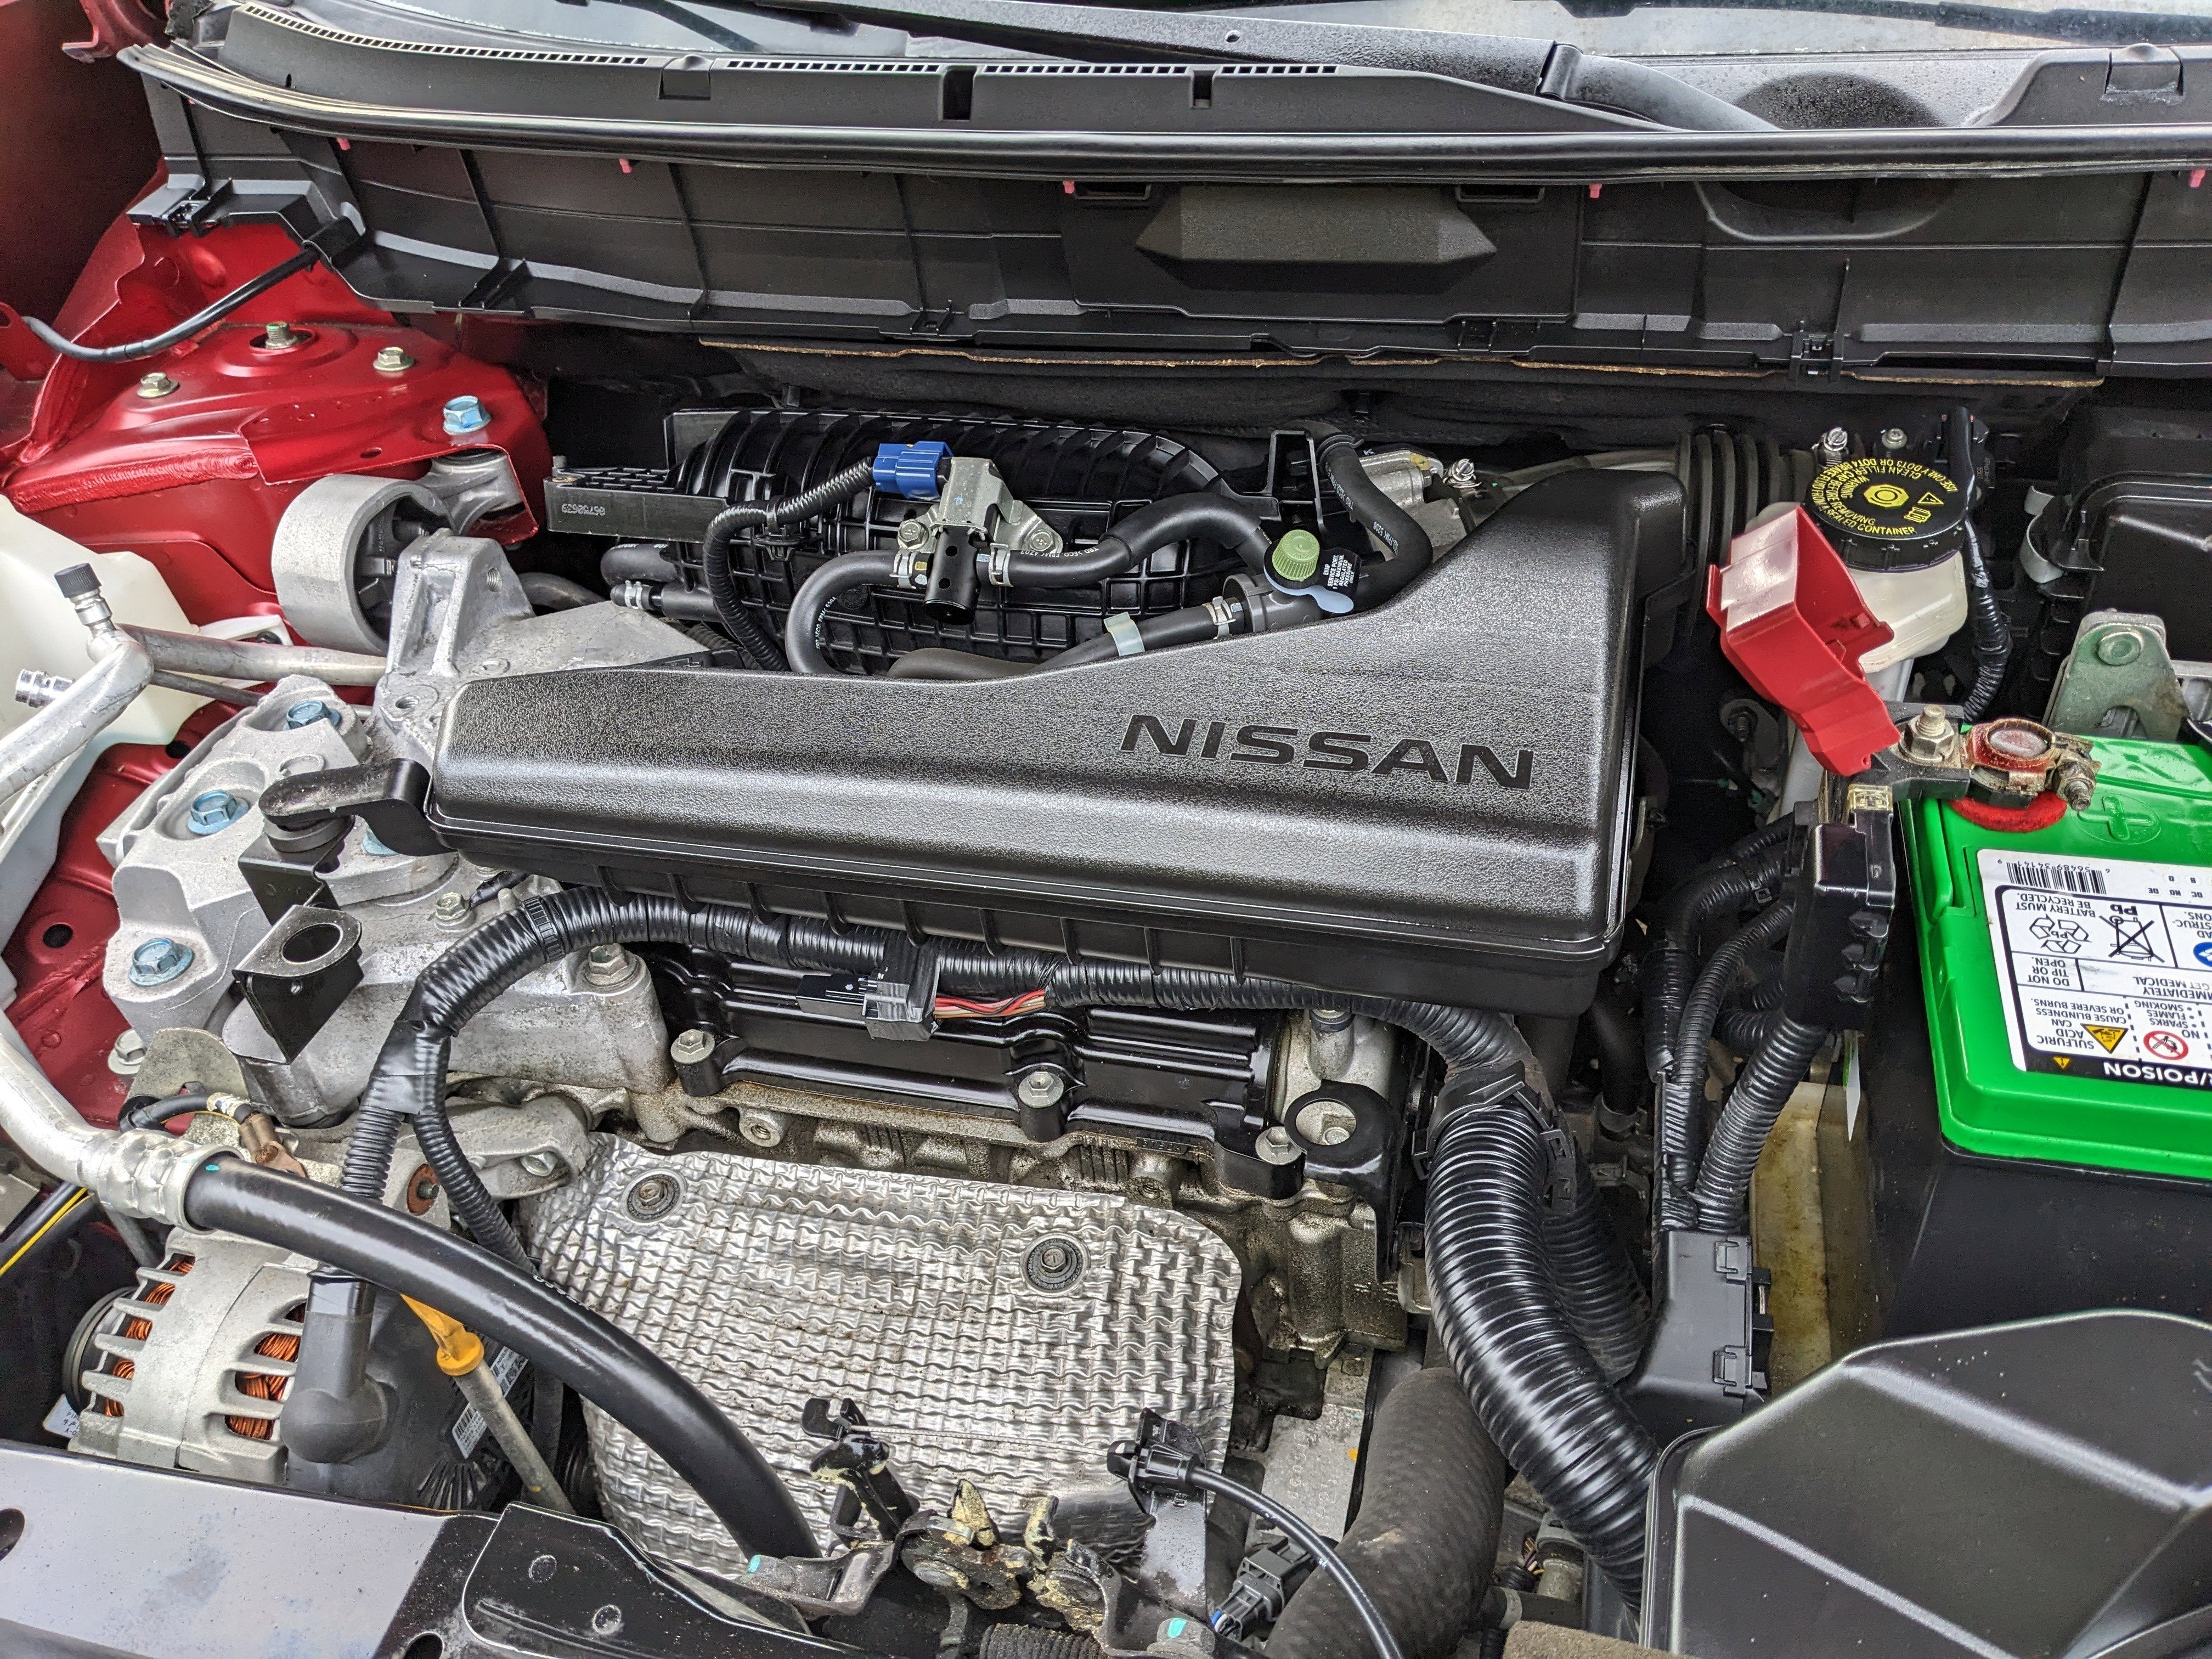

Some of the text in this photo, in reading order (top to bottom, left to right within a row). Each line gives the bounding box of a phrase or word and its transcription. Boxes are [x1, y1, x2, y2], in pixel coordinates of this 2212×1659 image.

[1852, 458, 1876, 467] DOT4
[1897, 461, 1922, 472] DOT3
[1824, 462, 1853, 477] BRAKE
[1921, 469, 1946, 481] ONLY
[1812, 474, 1831, 489] FLUID
[1841, 475, 1870, 499] WARNING
[1939, 480, 1958, 492] USE
[1812, 489, 1827, 505] FROM
[1826, 466, 1921, 525] CLEAN FILLER CAP BEFORE REMOVING
[1827, 509, 1857, 527] SEALED
[1858, 524, 1915, 535] CONTAINER
[1336, 554, 1345, 578] MAXIMUM.
[1328, 566, 1336, 586] SERVICE
[1339, 560, 1348, 586] REGULATED
[1344, 562, 1352, 587] PRESSURE
[1120, 714, 1534, 791] NISSAN
[2017, 860, 2051, 870] 34141
[2057, 864, 2091, 873] 56489
[2017, 893, 2074, 907] RECYCLED.
[2016, 902, 2096, 917] BATTERY MUST
[2110, 904, 2138, 916] Pb
[2051, 930, 2068, 939] Pb
[2031, 957, 2066, 968] OPEN.
[2032, 966, 2069, 977] TIP OR
[2027, 974, 2070, 986] DO NOT
[2132, 976, 2210, 991] GET MEDICAL
[2030, 998, 2124, 1015] OR SEVERE BURNS.
[2134, 1000, 2184, 1012] SMOKING
[2035, 1008, 2126, 1024] CAUSE BLINDNESS
[2146, 1009, 2186, 1020] FLAMES
[2051, 1018, 2072, 1028] CAN
[2149, 1018, 2188, 1029] SPARKS
[2056, 1028, 2084, 1039] ACID
[2181, 1029, 2200, 1039] NO
[2036, 1035, 2095, 1049] SULFURIC
